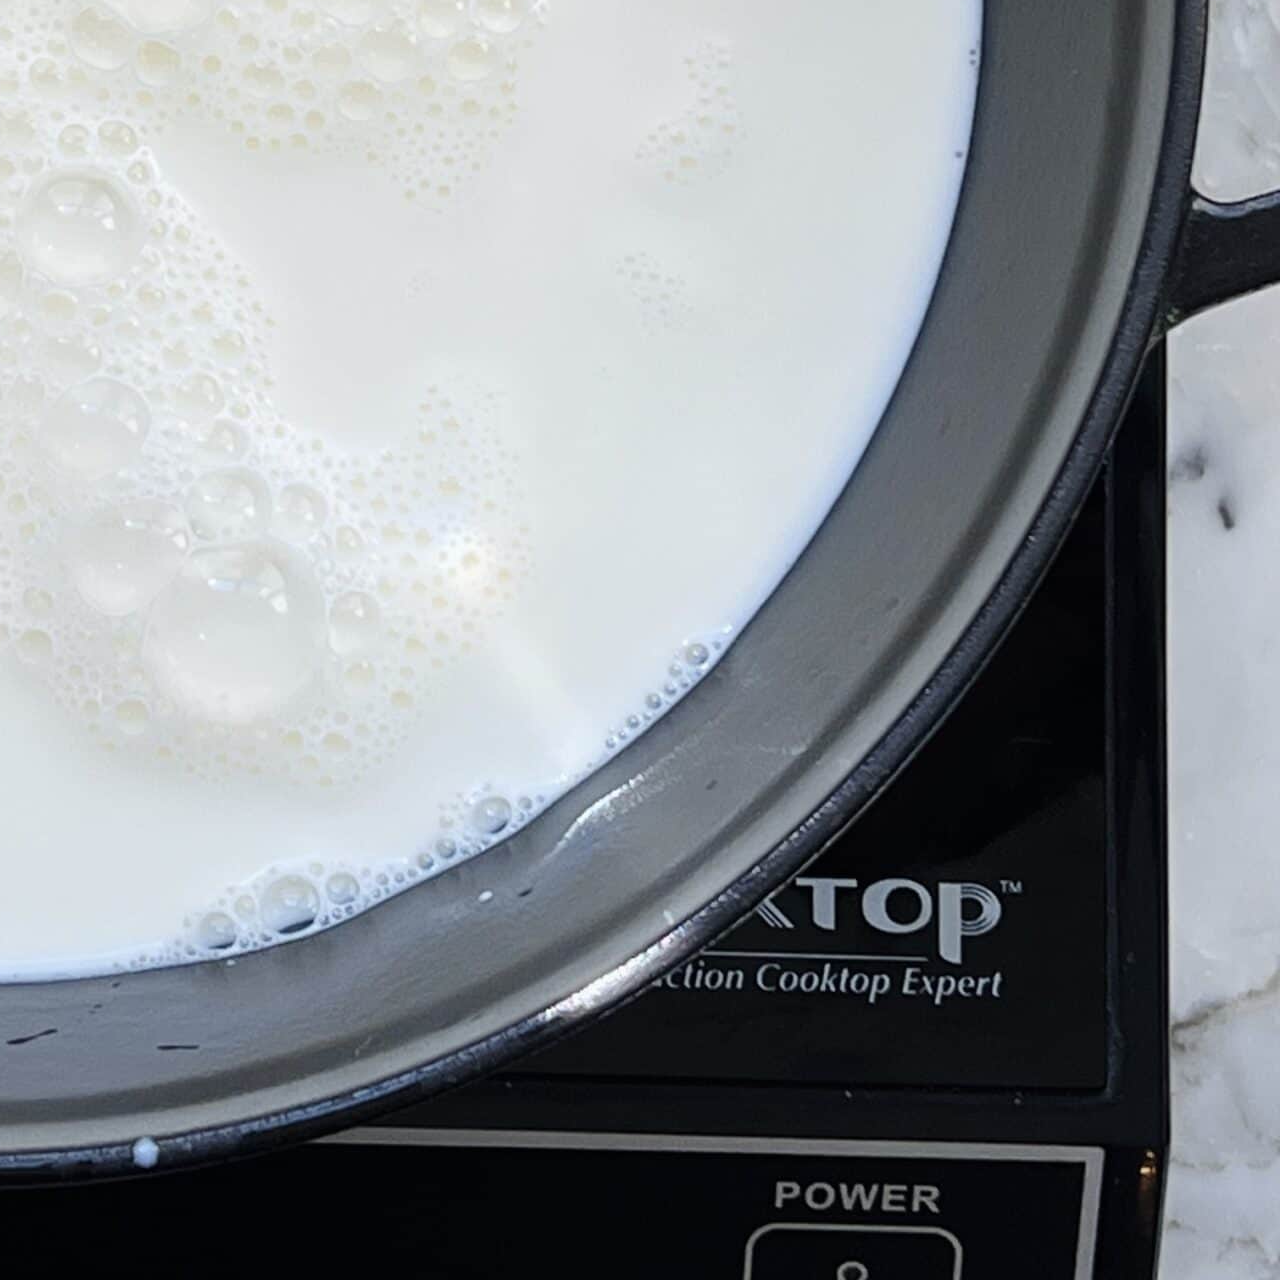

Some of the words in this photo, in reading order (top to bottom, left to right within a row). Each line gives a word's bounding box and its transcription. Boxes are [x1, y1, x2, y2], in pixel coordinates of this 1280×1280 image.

[755, 962, 891, 1004] Cooktop
[901, 967, 1003, 1006] Expert
[774, 1181, 941, 1213] POWER
